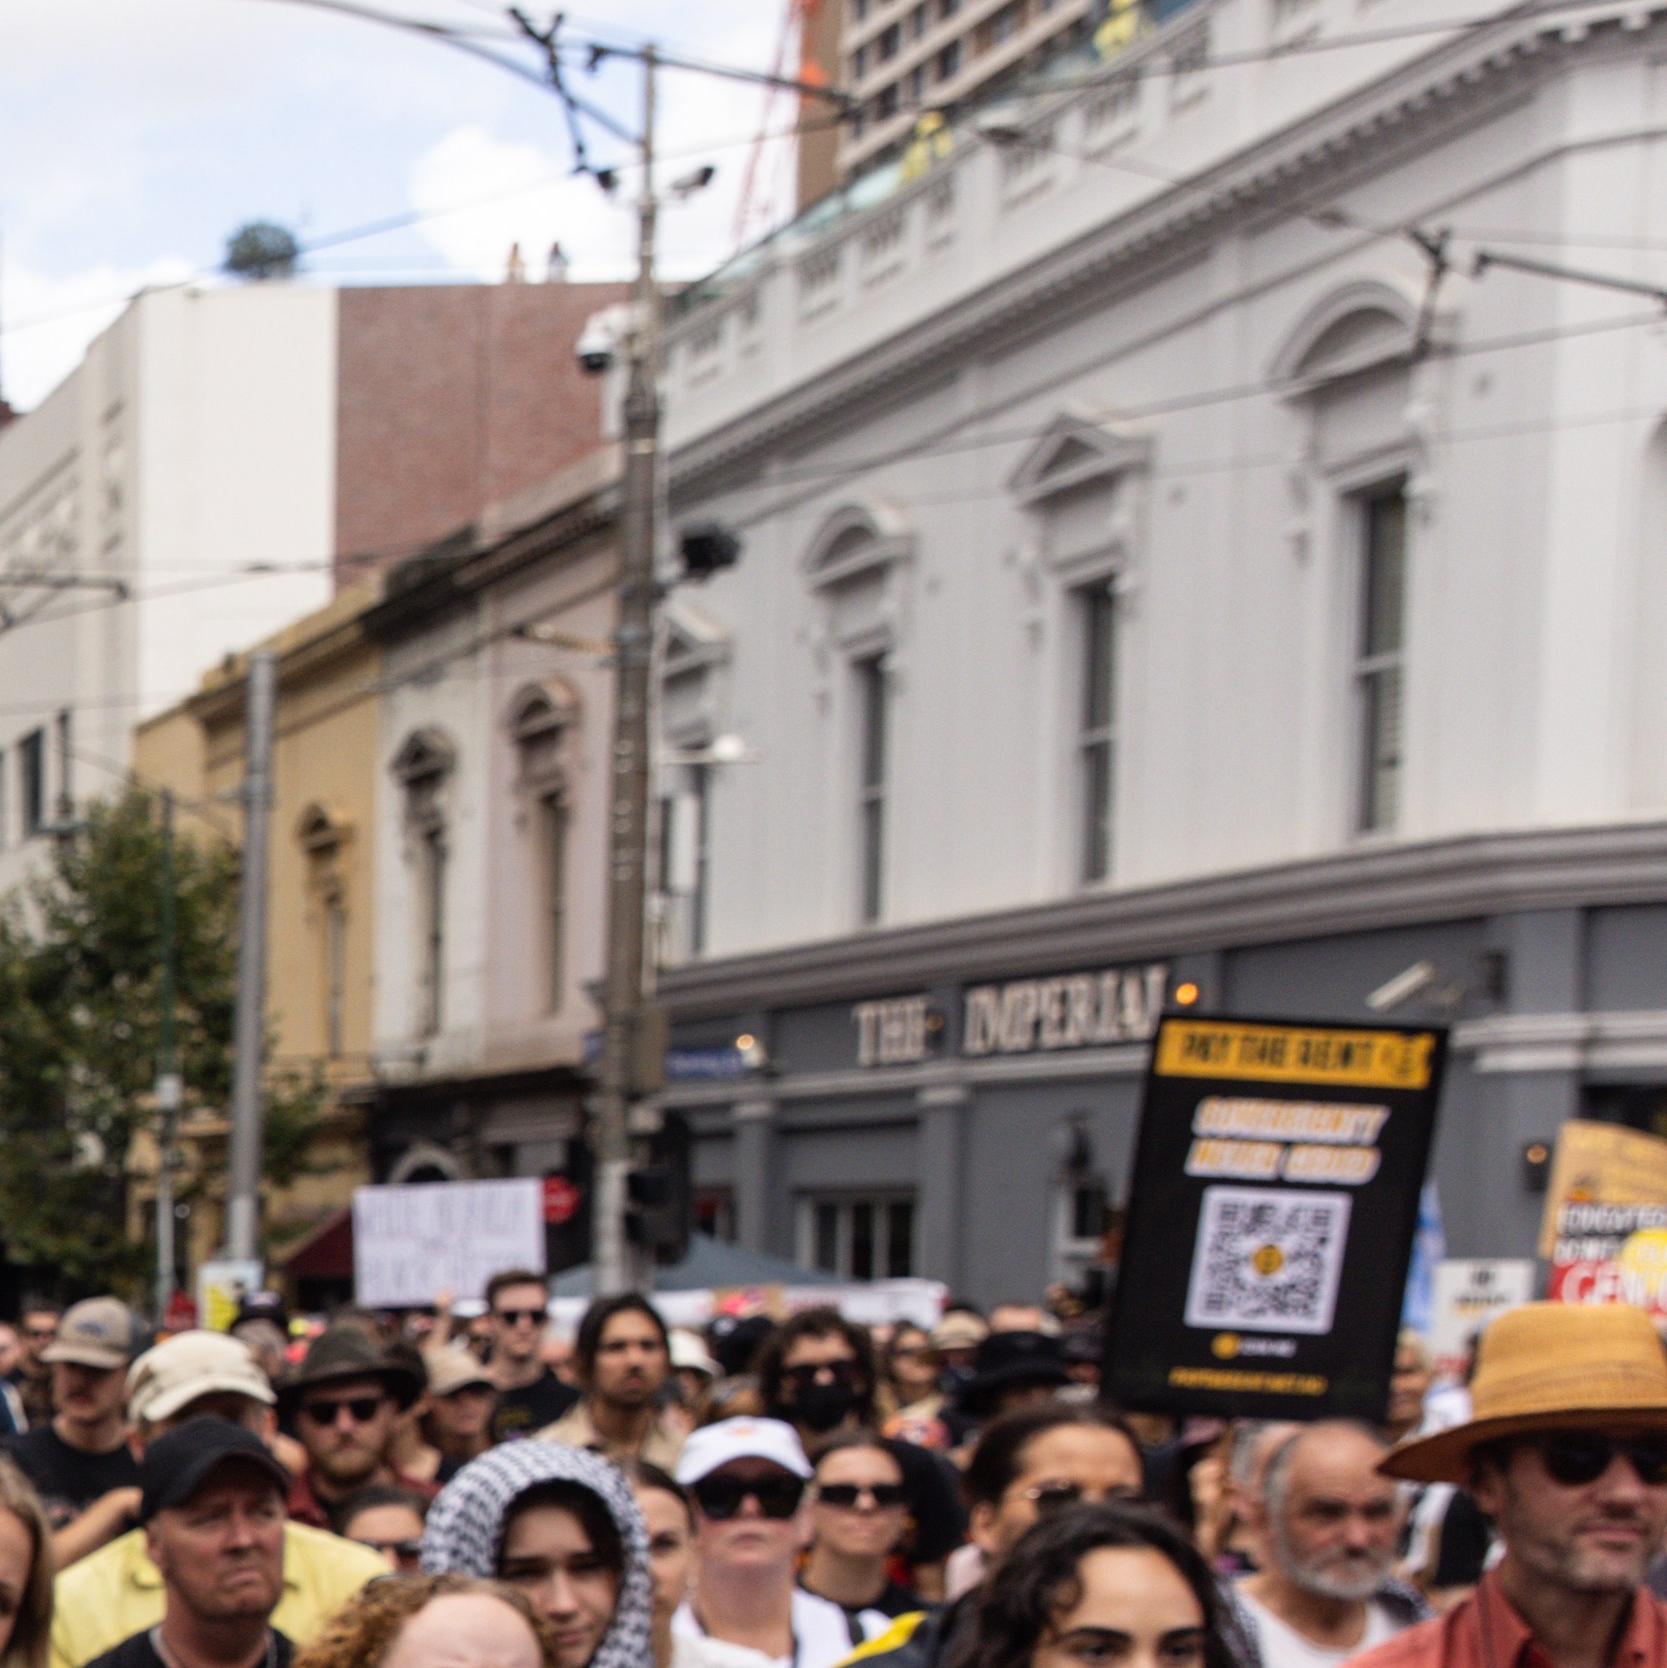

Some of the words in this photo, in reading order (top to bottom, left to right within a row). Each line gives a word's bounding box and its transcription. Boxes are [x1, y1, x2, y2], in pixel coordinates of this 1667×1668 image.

[853, 997, 927, 1067] THE
[1183, 1032, 1231, 1064] PAY
[1238, 1034, 1287, 1069] THE
[1299, 1038, 1374, 1074] RENT
